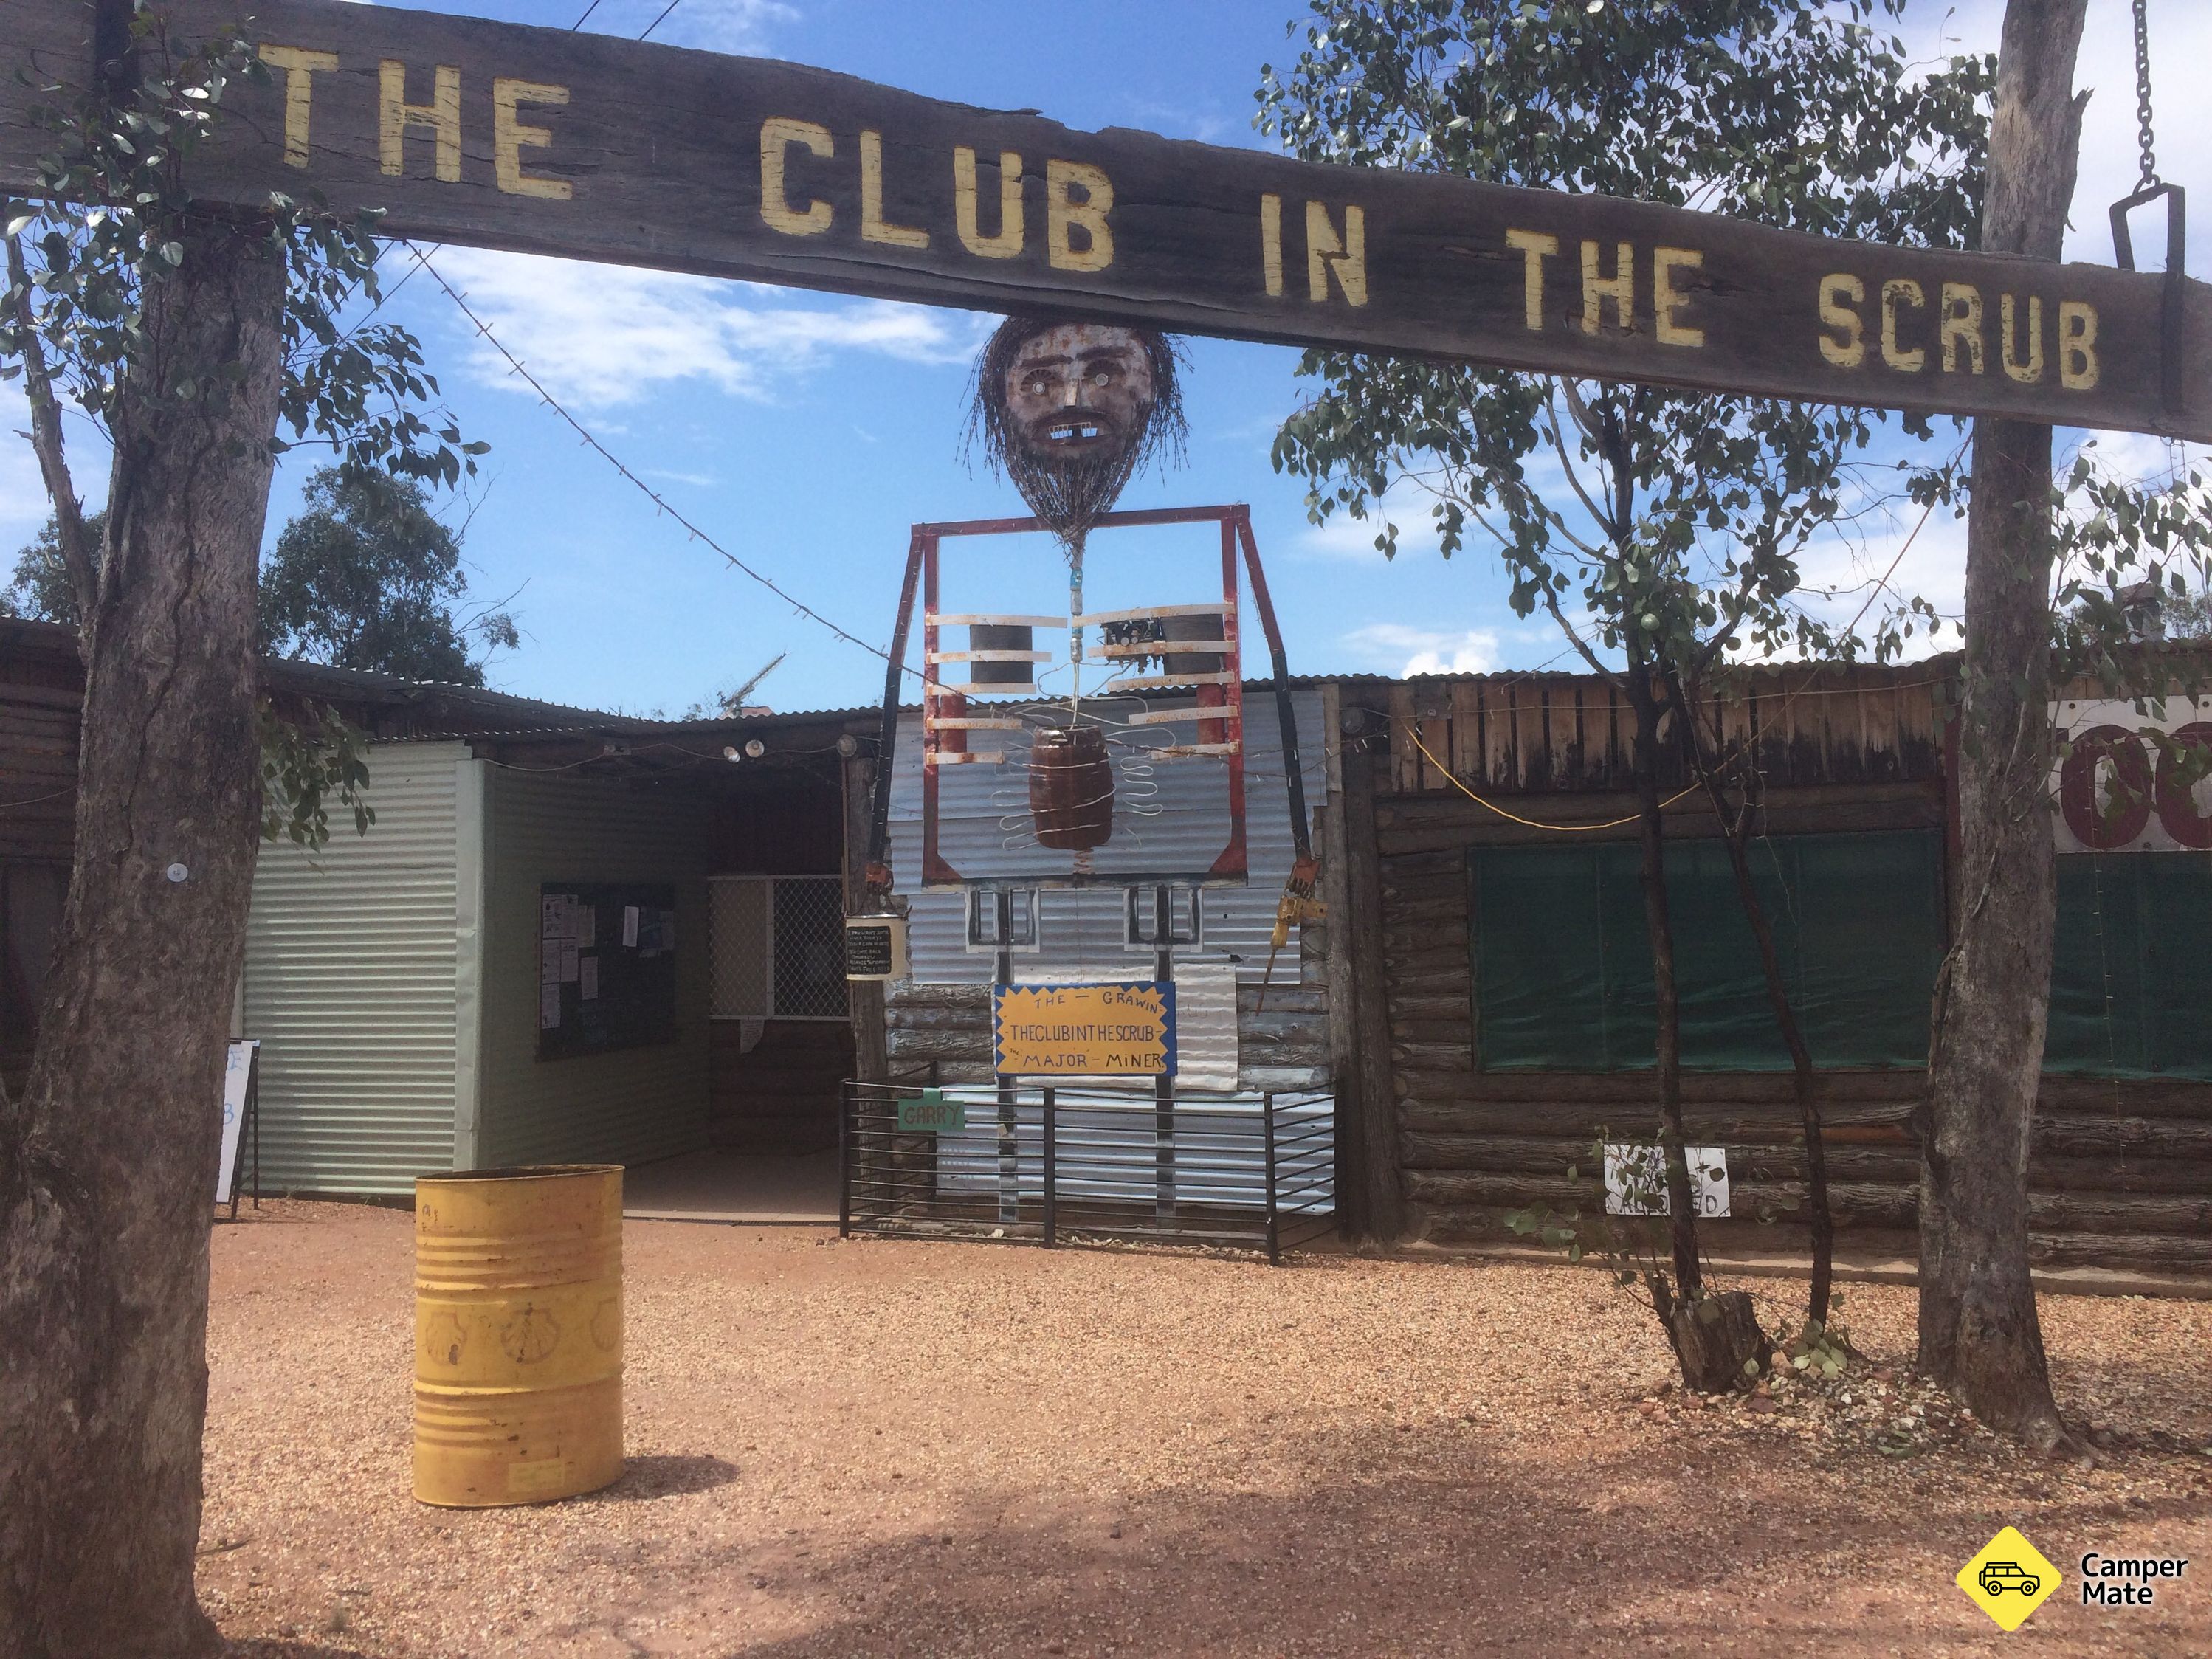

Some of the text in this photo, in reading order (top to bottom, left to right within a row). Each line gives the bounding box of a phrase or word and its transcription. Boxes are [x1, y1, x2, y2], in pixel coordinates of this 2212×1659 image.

[258, 43, 2101, 390] THE CLUB IN THE SCRUB
[1035, 995, 1065, 1009] THE
[1023, 1054, 1087, 1068] MAJOR
[904, 1105, 962, 1125] GARRY
